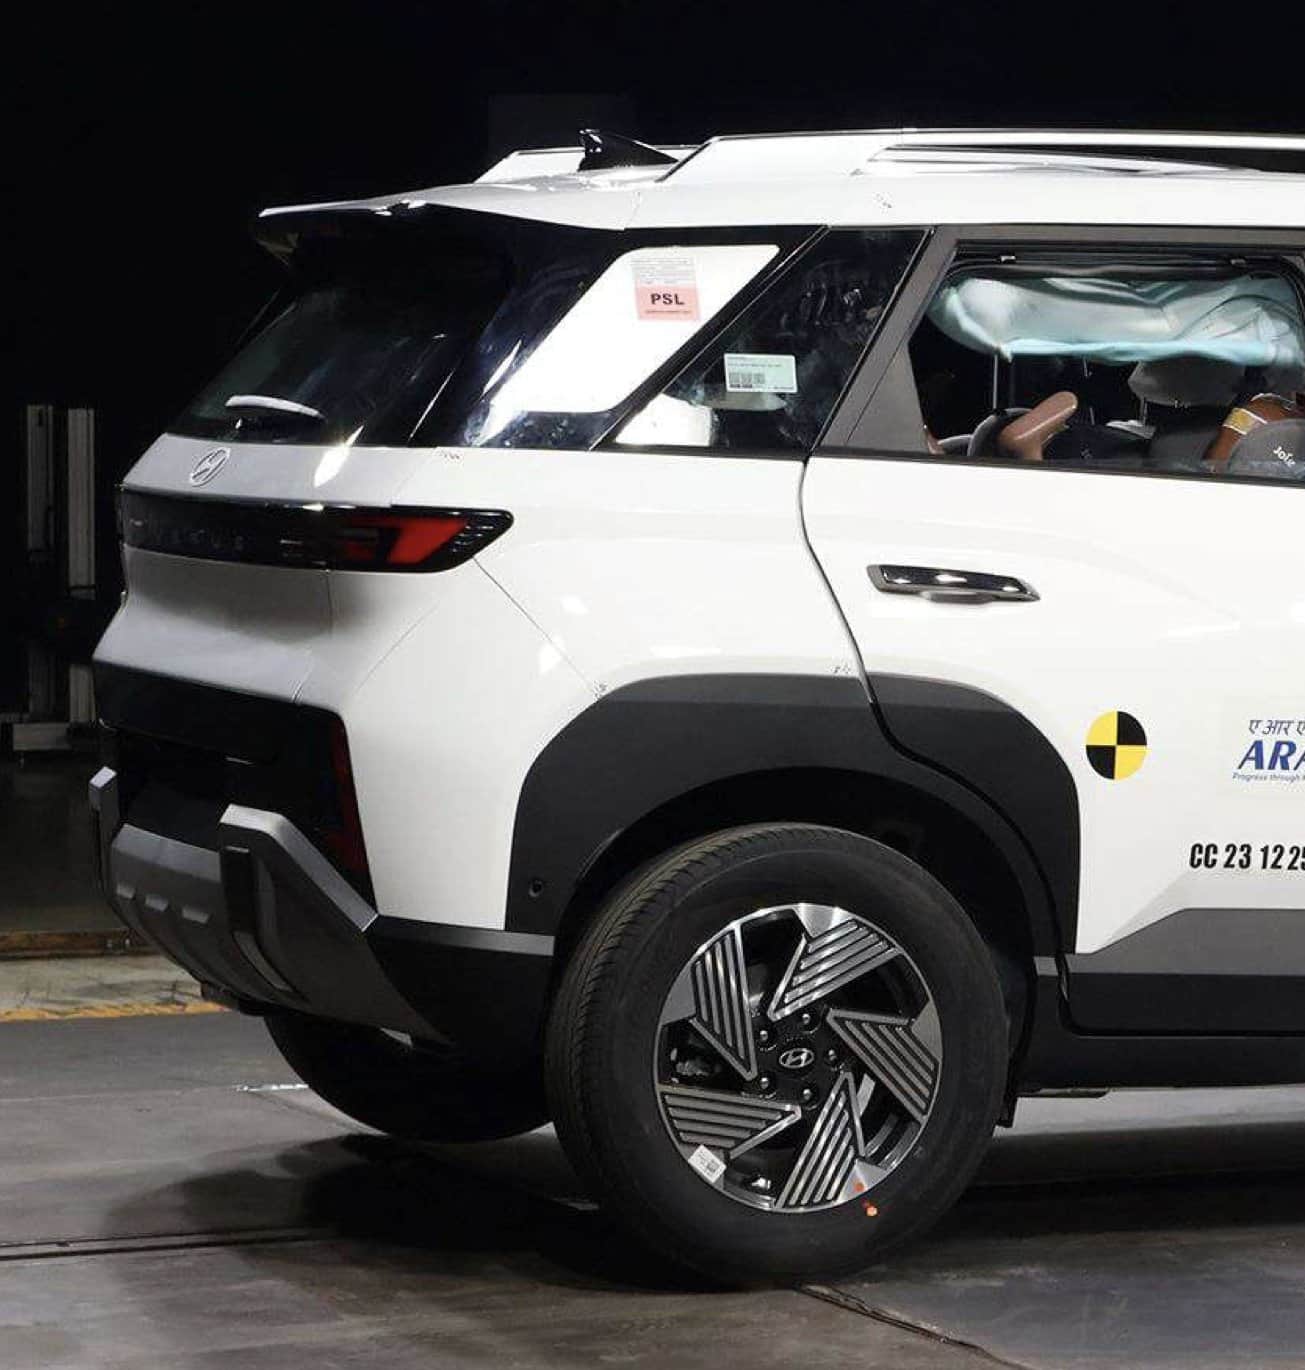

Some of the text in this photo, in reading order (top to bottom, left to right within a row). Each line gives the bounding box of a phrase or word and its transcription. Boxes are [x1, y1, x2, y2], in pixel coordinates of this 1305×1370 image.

[650, 293, 686, 306] PSL
[1248, 719, 1263, 735] ए
[1262, 719, 1295, 736] आर
[1189, 843, 1218, 869] CC
[1223, 843, 1252, 869] 23
